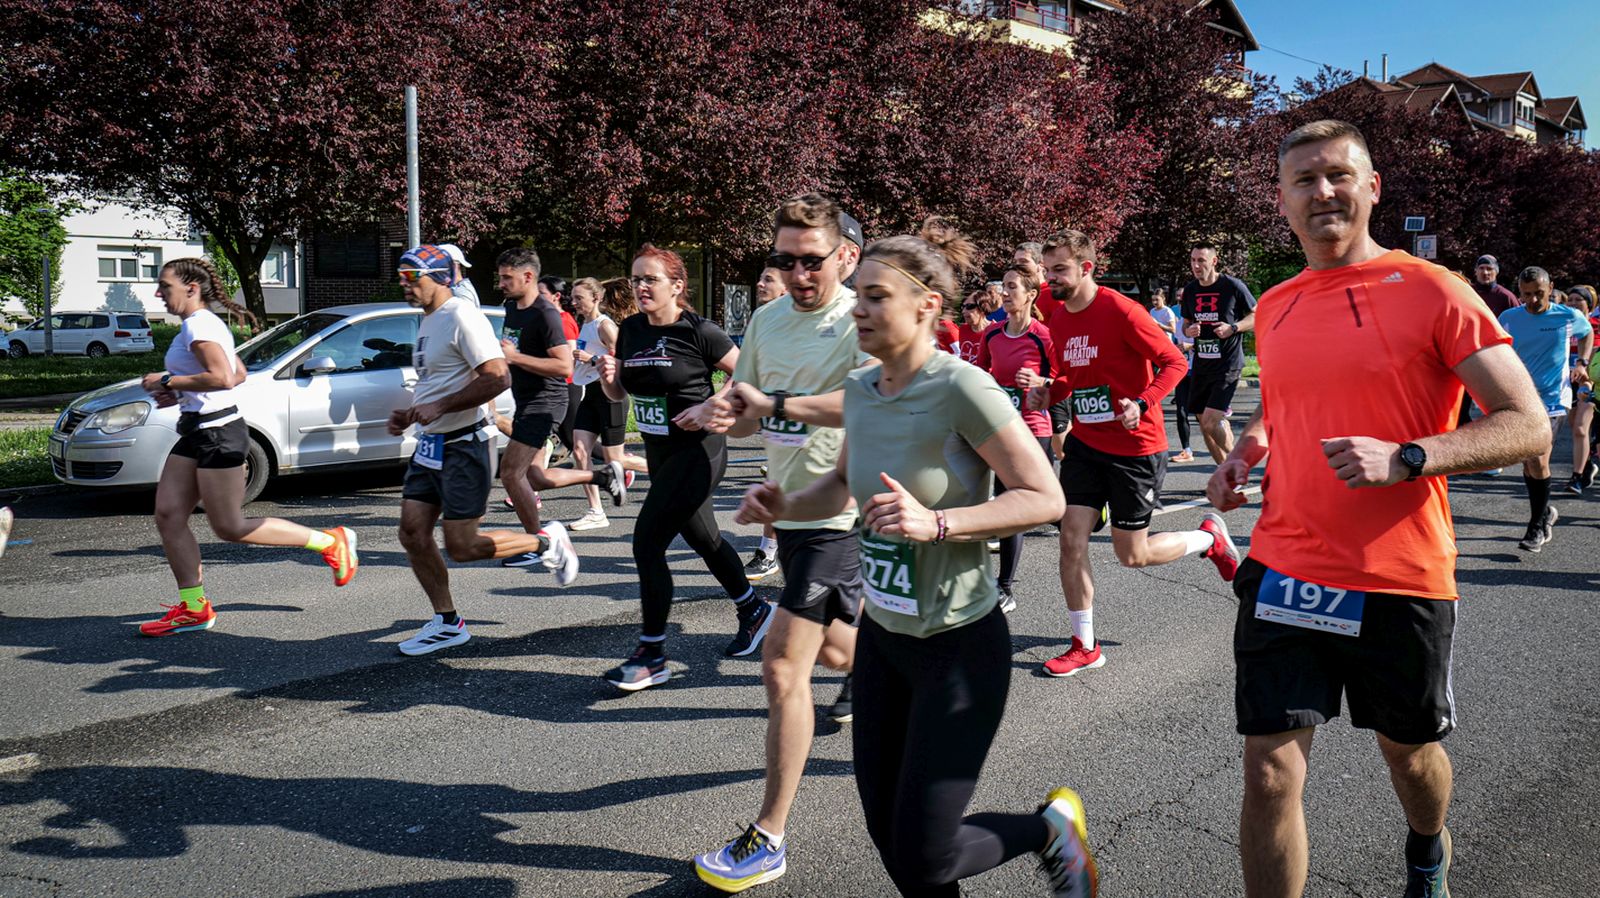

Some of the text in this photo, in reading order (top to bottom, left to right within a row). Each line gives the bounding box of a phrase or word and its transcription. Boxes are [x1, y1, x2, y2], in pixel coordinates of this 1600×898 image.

[1063, 345, 1098, 362] MARATON
[1198, 344, 1219, 353] 1176
[1074, 395, 1109, 414] 1096
[634, 404, 665, 425] 1145
[1278, 577, 1347, 614] 197
